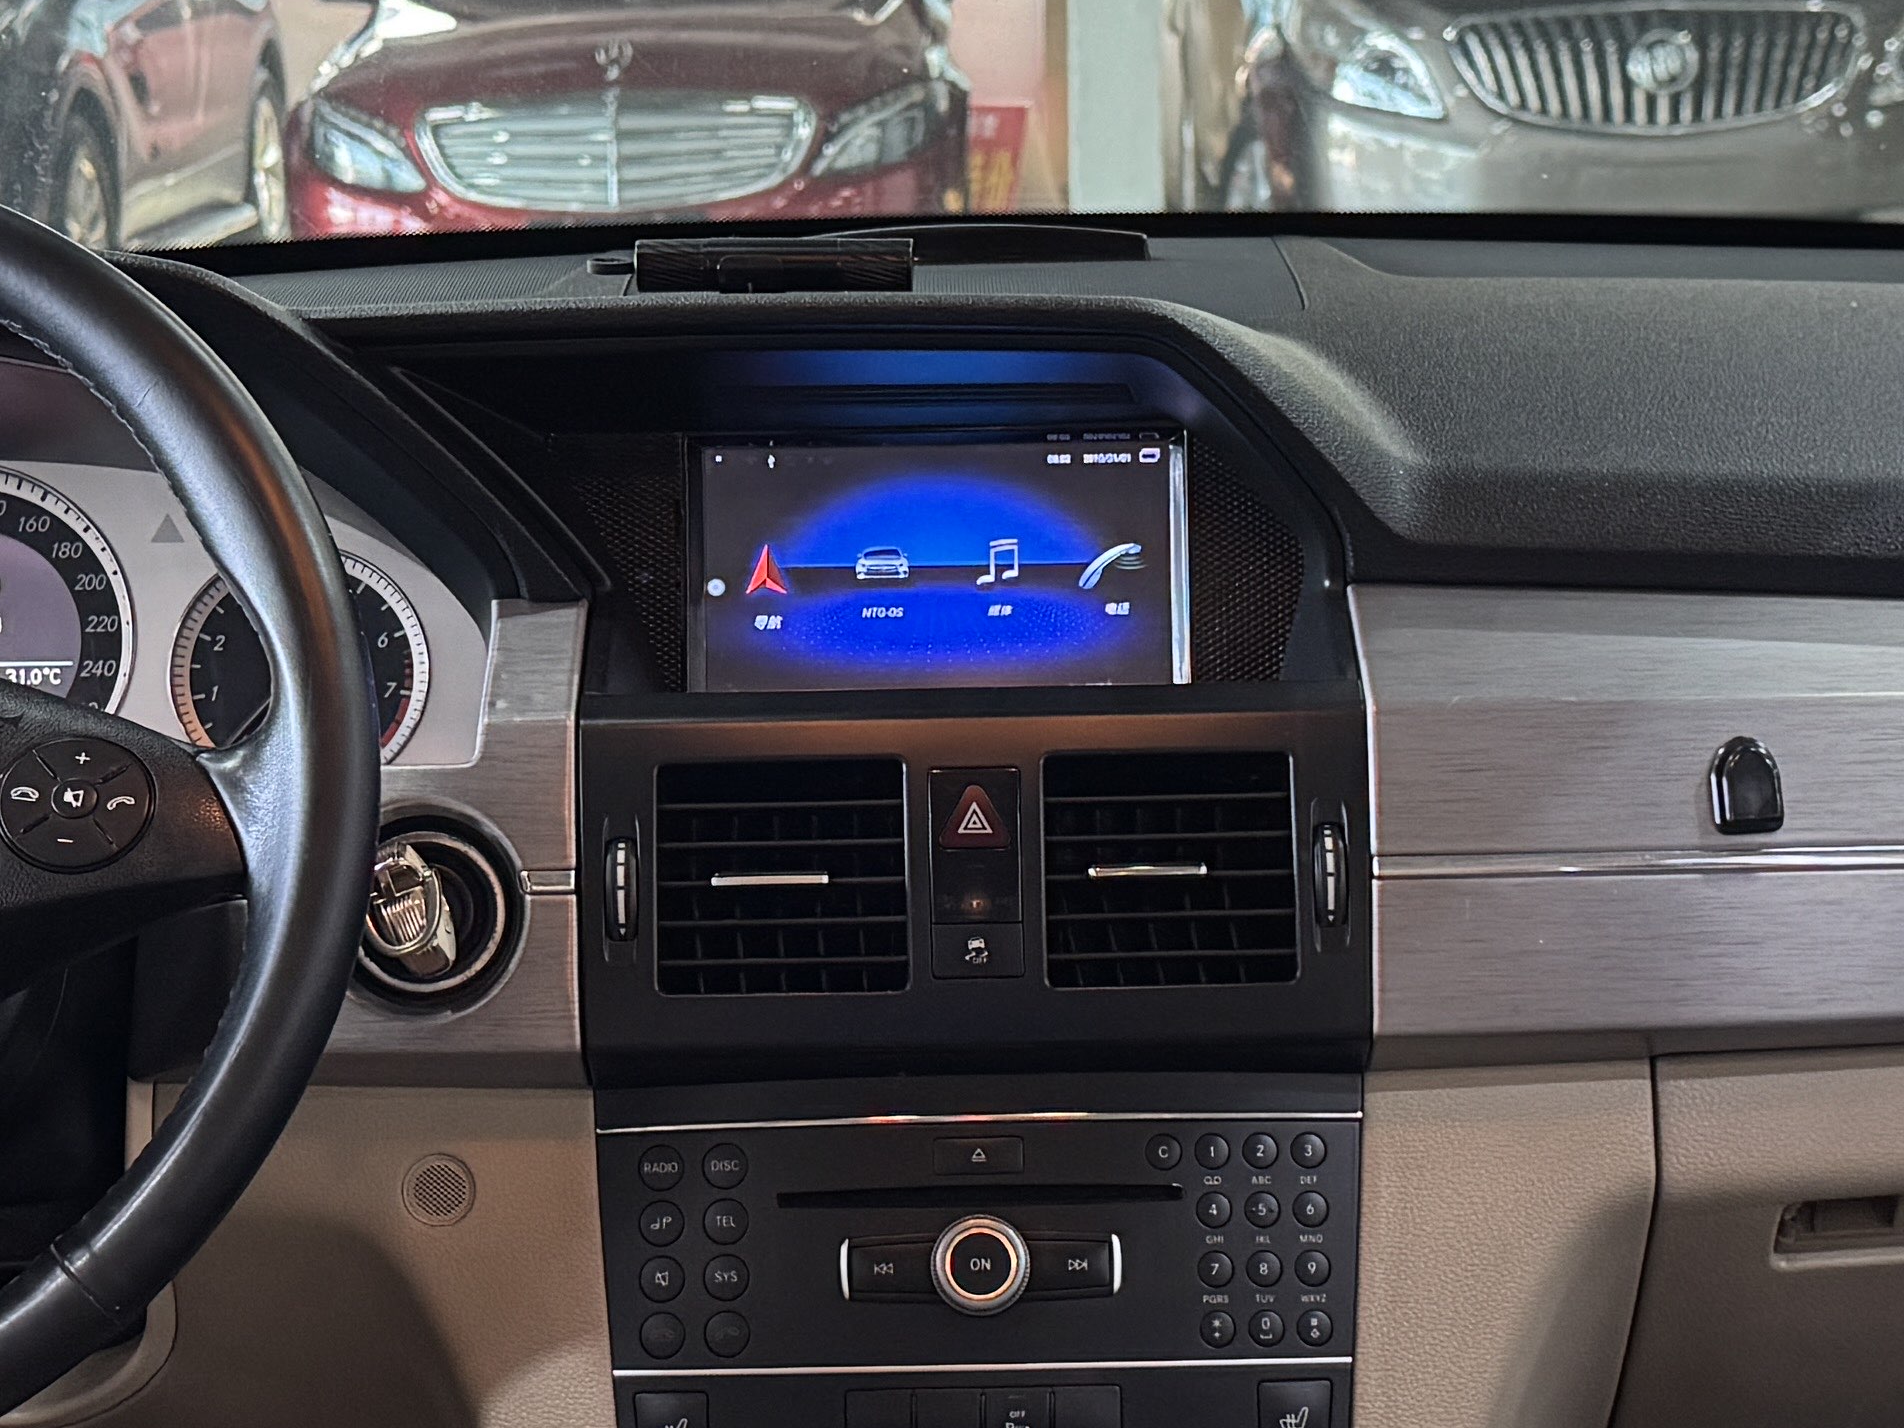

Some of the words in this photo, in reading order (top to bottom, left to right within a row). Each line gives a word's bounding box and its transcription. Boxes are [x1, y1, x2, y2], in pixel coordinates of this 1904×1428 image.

[18, 516, 51, 533] 160
[51, 542, 82, 559] 180
[74, 574, 106, 592] 200
[85, 615, 119, 633] 220
[213, 635, 226, 652] 2
[377, 632, 389, 649] 6
[80, 660, 116, 678] 240
[211, 685, 219, 701] 1
[384, 682, 397, 698] 7
[1158, 1146, 1169, 1158] C
[1256, 1144, 1264, 1157] 2
[1304, 1144, 1313, 1157] 3
[643, 1161, 679, 1174] RADIO
[710, 1159, 740, 1172] DISC
[1251, 1176, 1272, 1185] ABC
[1208, 1203, 1218, 1215] 4
[1257, 1203, 1266, 1216] 5
[1306, 1203, 1315, 1215] 6
[716, 1215, 736, 1228] TEL
[1299, 1234, 1324, 1244] MNO
[969, 1258, 992, 1272] ON
[1210, 1263, 1220, 1275] 7
[1259, 1263, 1268, 1275] 8
[1307, 1261, 1317, 1275] 9
[713, 1270, 738, 1283] SYS
[1261, 1317, 1270, 1329] 0
